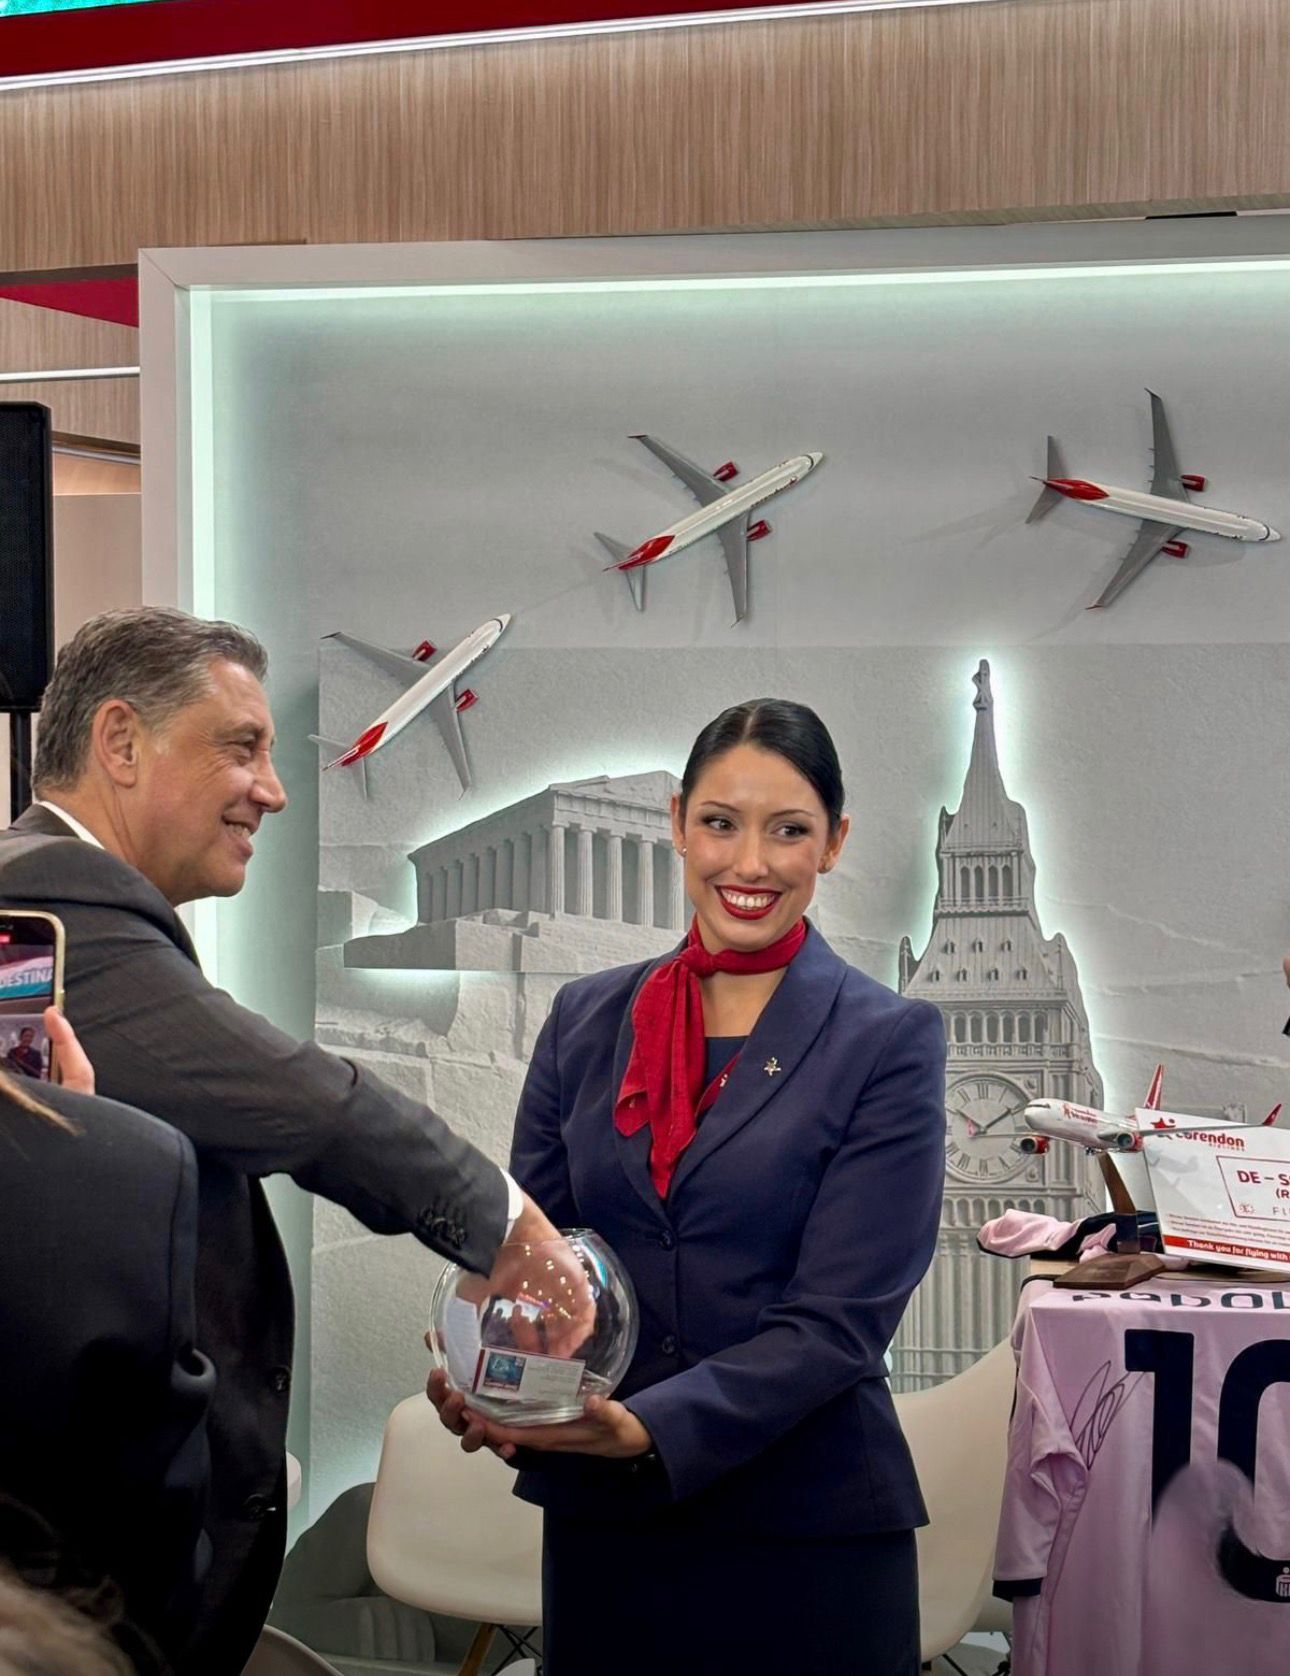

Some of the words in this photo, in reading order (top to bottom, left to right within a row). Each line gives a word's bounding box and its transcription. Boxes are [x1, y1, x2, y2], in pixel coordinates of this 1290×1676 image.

[1237, 1170, 1261, 1184] DE
[1278, 1173, 1290, 1186] S
[1186, 1239, 1214, 1251] Thank
[1215, 1244, 1231, 1253] you
[1232, 1245, 1244, 1255] for
[1245, 1247, 1269, 1260] flying
[1270, 1251, 1288, 1261] with
